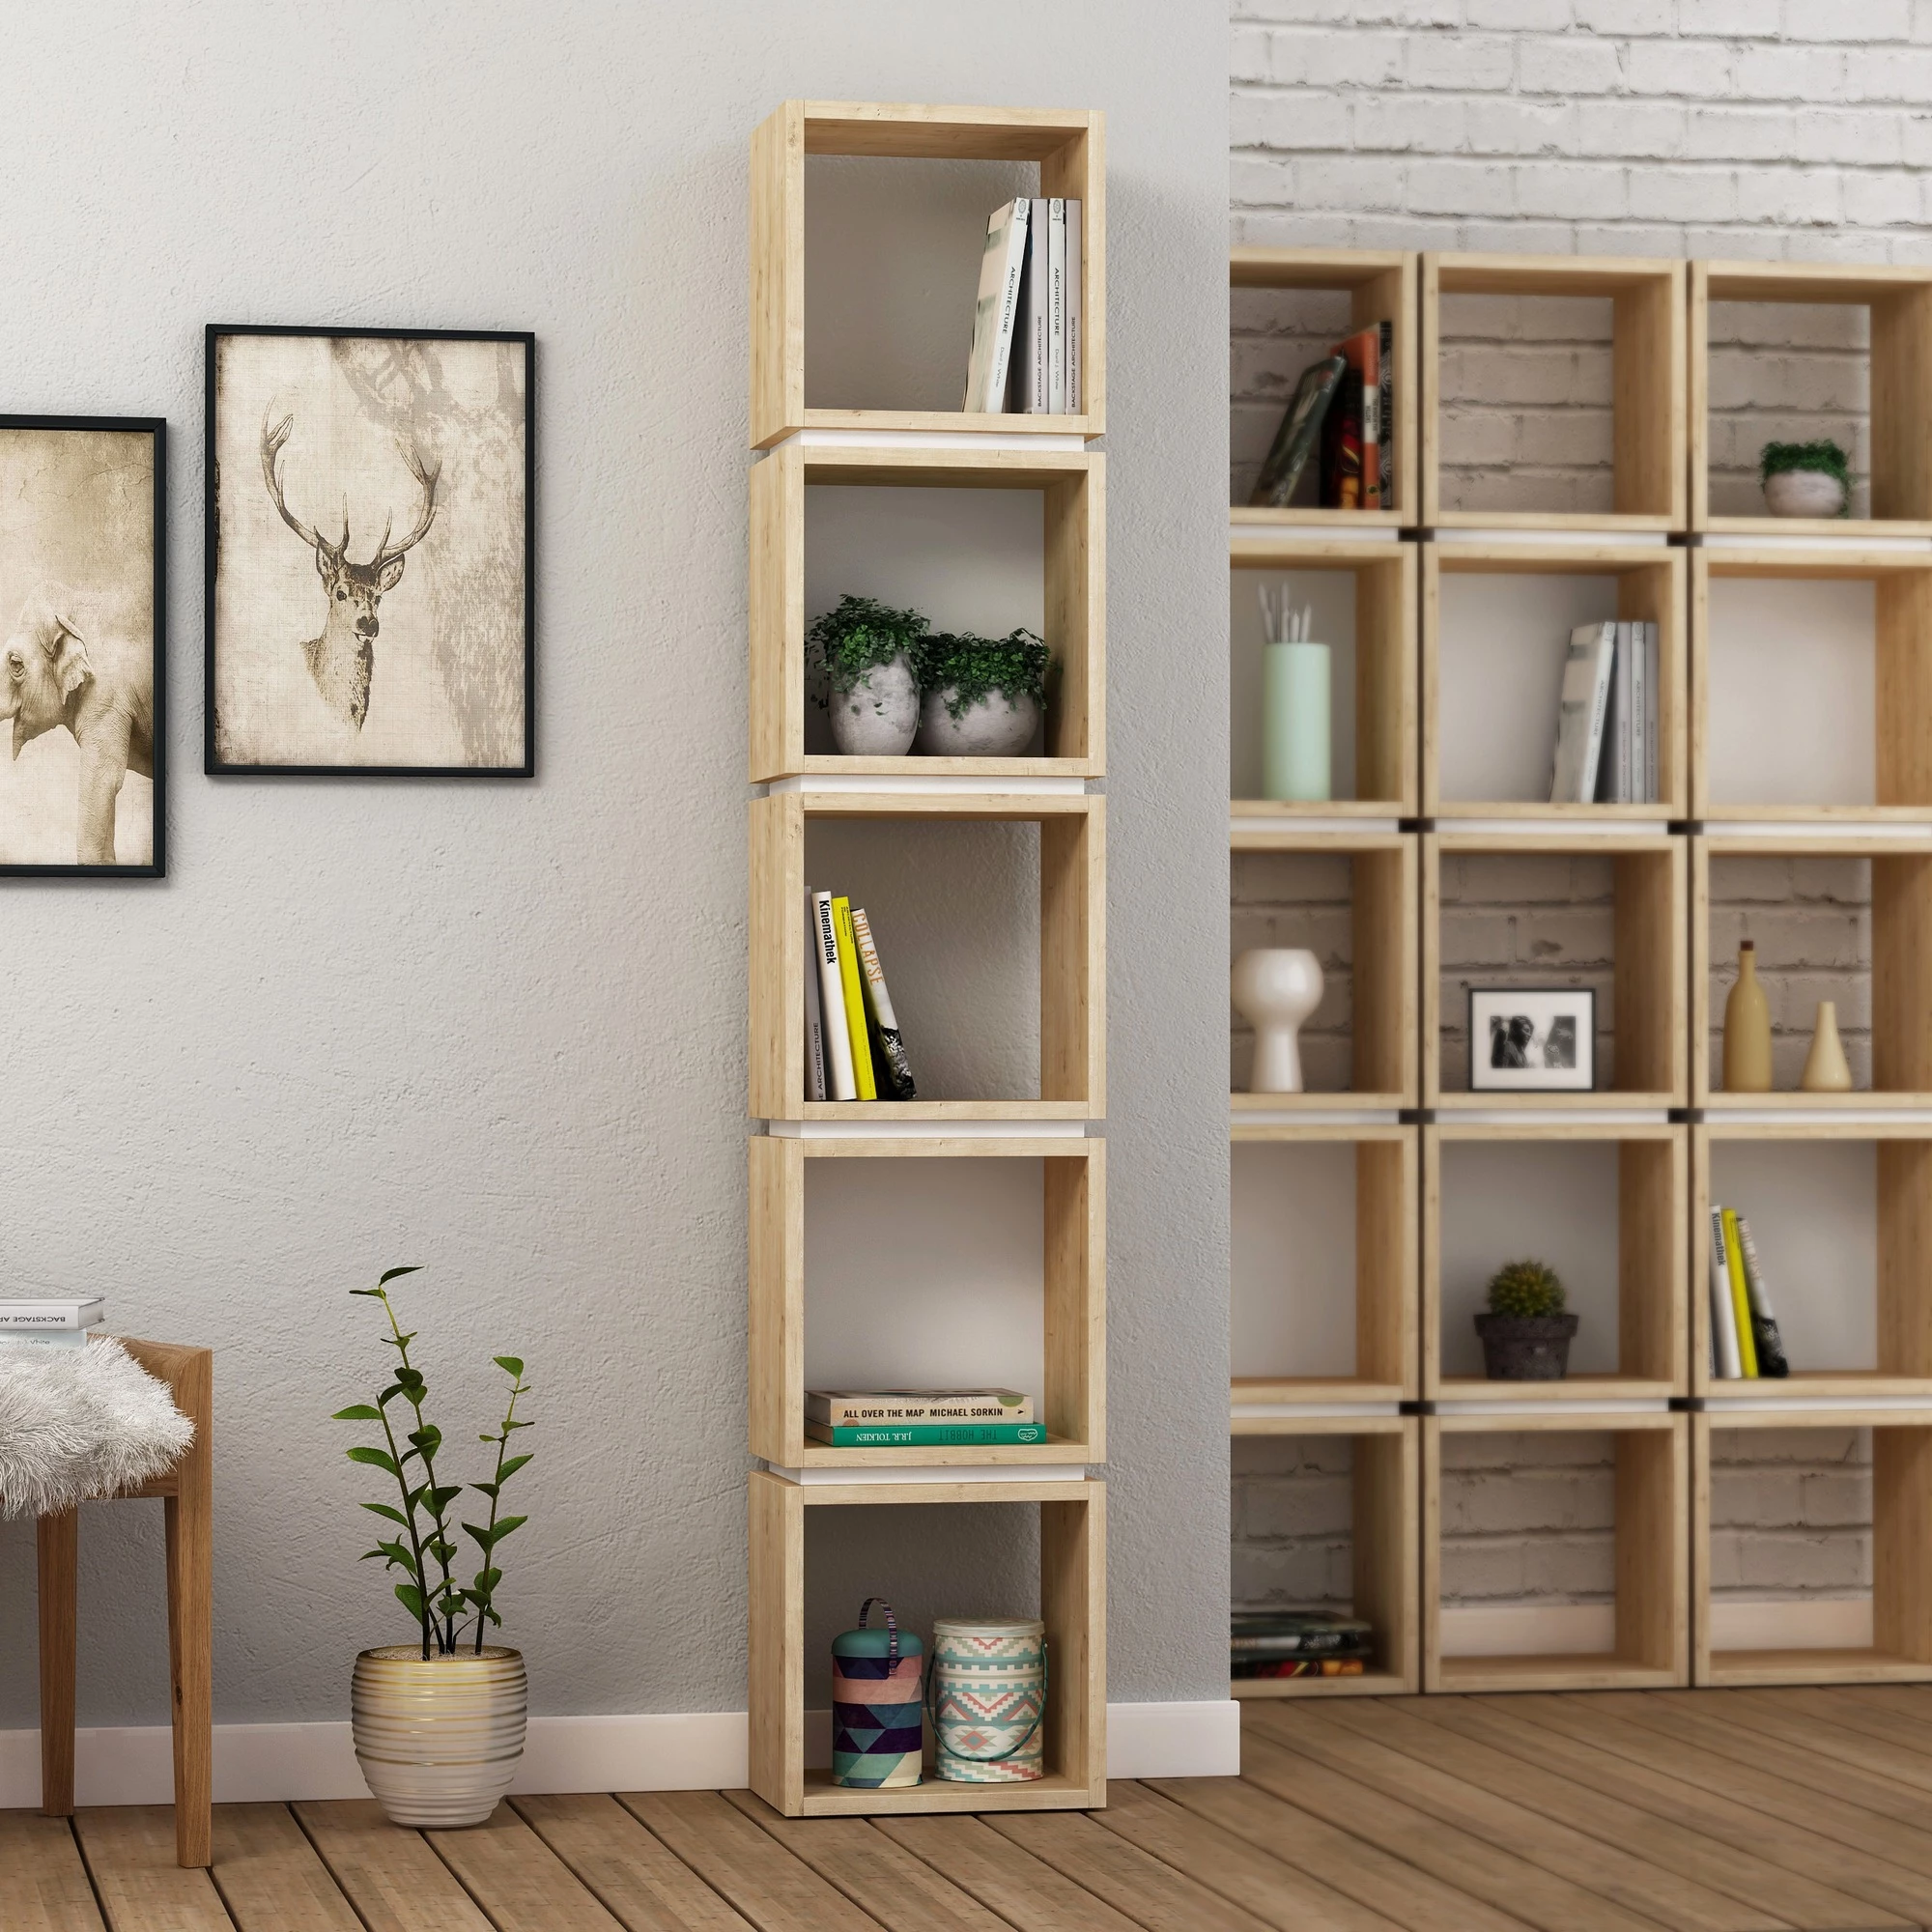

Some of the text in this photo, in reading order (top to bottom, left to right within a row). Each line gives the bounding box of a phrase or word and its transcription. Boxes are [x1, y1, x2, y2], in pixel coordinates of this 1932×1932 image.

[1002, 267, 1016, 334] ARCHITECTURE
[818, 899, 837, 965] Kinemathek
[852, 913, 885, 986] COLLAPSE
[812, 1022, 823, 1090] ARCHITECTURE
[1712, 1212, 1726, 1266] Kinemathek
[843, 1407, 1004, 1418] ALL OVER THE MAP MICHAEL SORKIN
[856, 1429, 998, 1442] THE HOBBIT J.R.R. TOLKIEN
